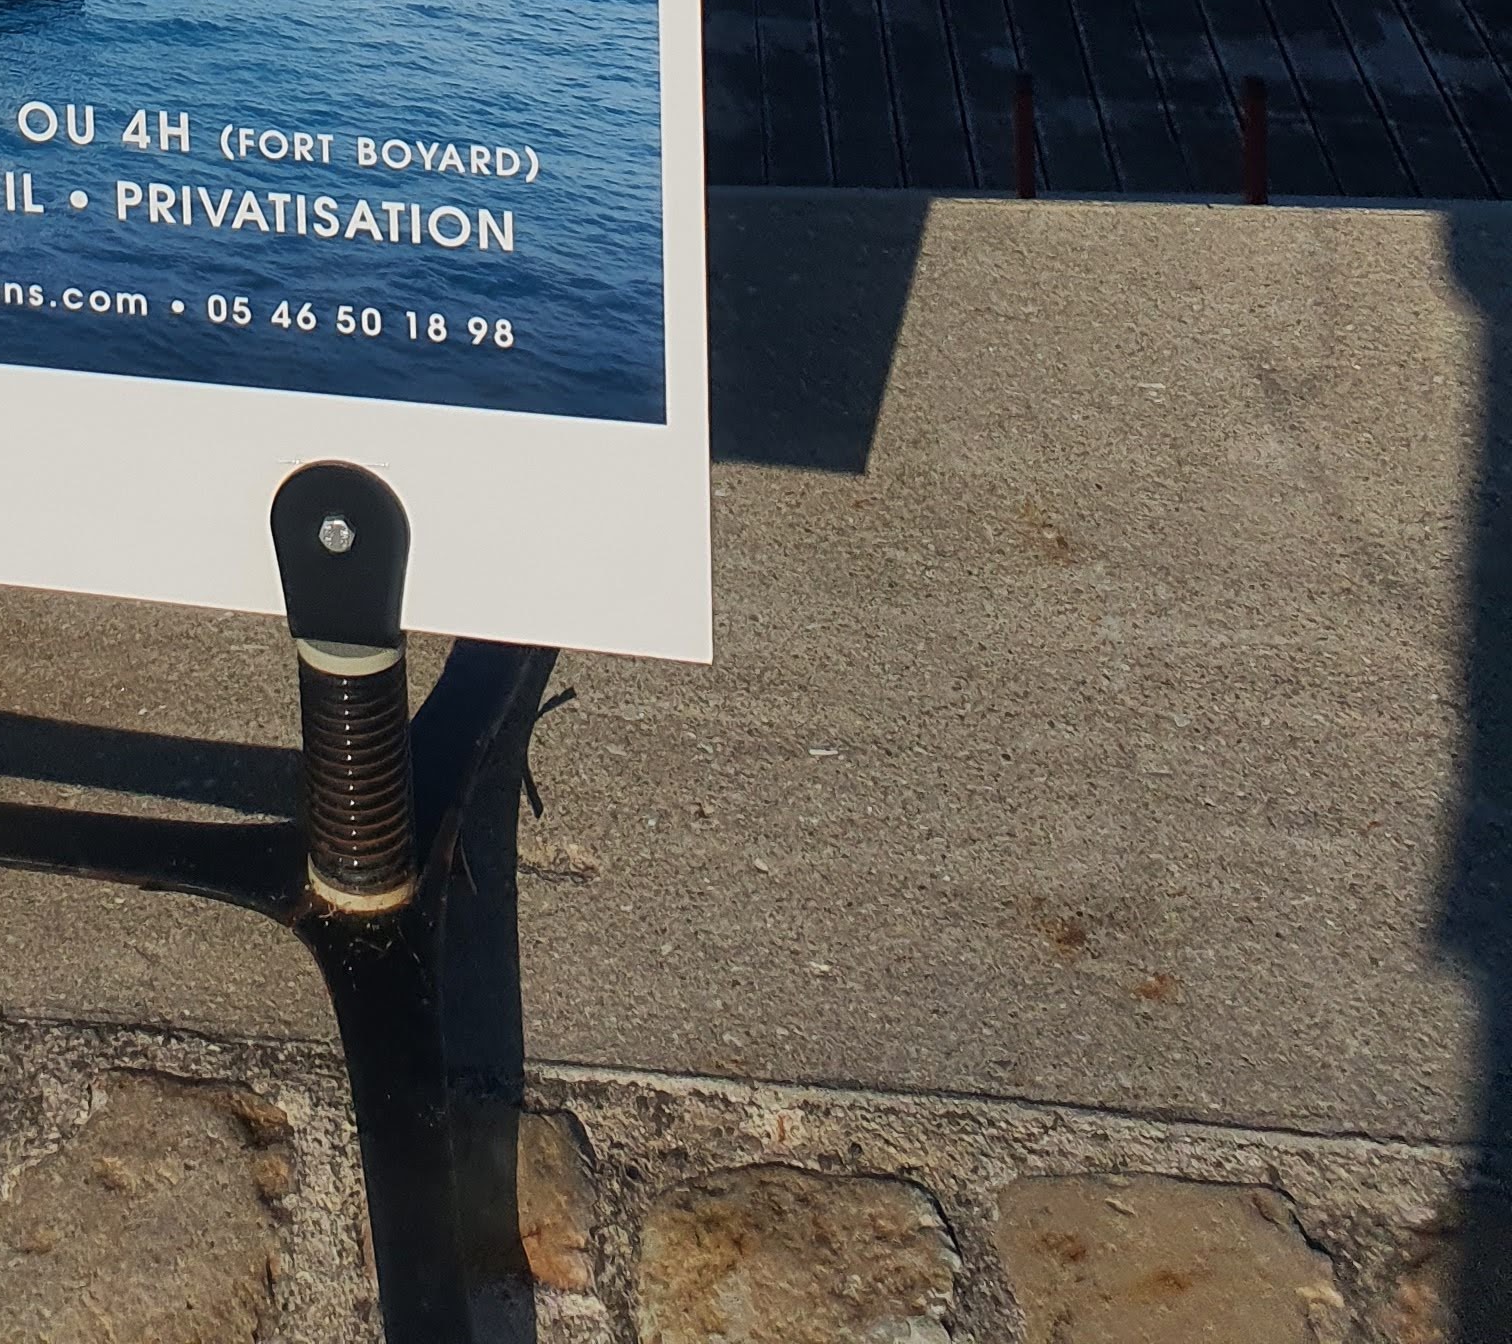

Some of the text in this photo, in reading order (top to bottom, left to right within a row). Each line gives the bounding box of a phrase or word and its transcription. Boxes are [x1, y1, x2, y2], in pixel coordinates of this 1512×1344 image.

[17, 100, 96, 146] OU
[121, 108, 191, 153] 4H
[220, 123, 335, 164] (FORT
[357, 136, 541, 184] BOYARD)
[116, 179, 515, 253] PRIVATISATION
[207, 293, 253, 327] 05
[271, 299, 318, 332] 46
[336, 305, 382, 339] 50
[405, 310, 448, 344] 18
[467, 316, 515, 350] 98
